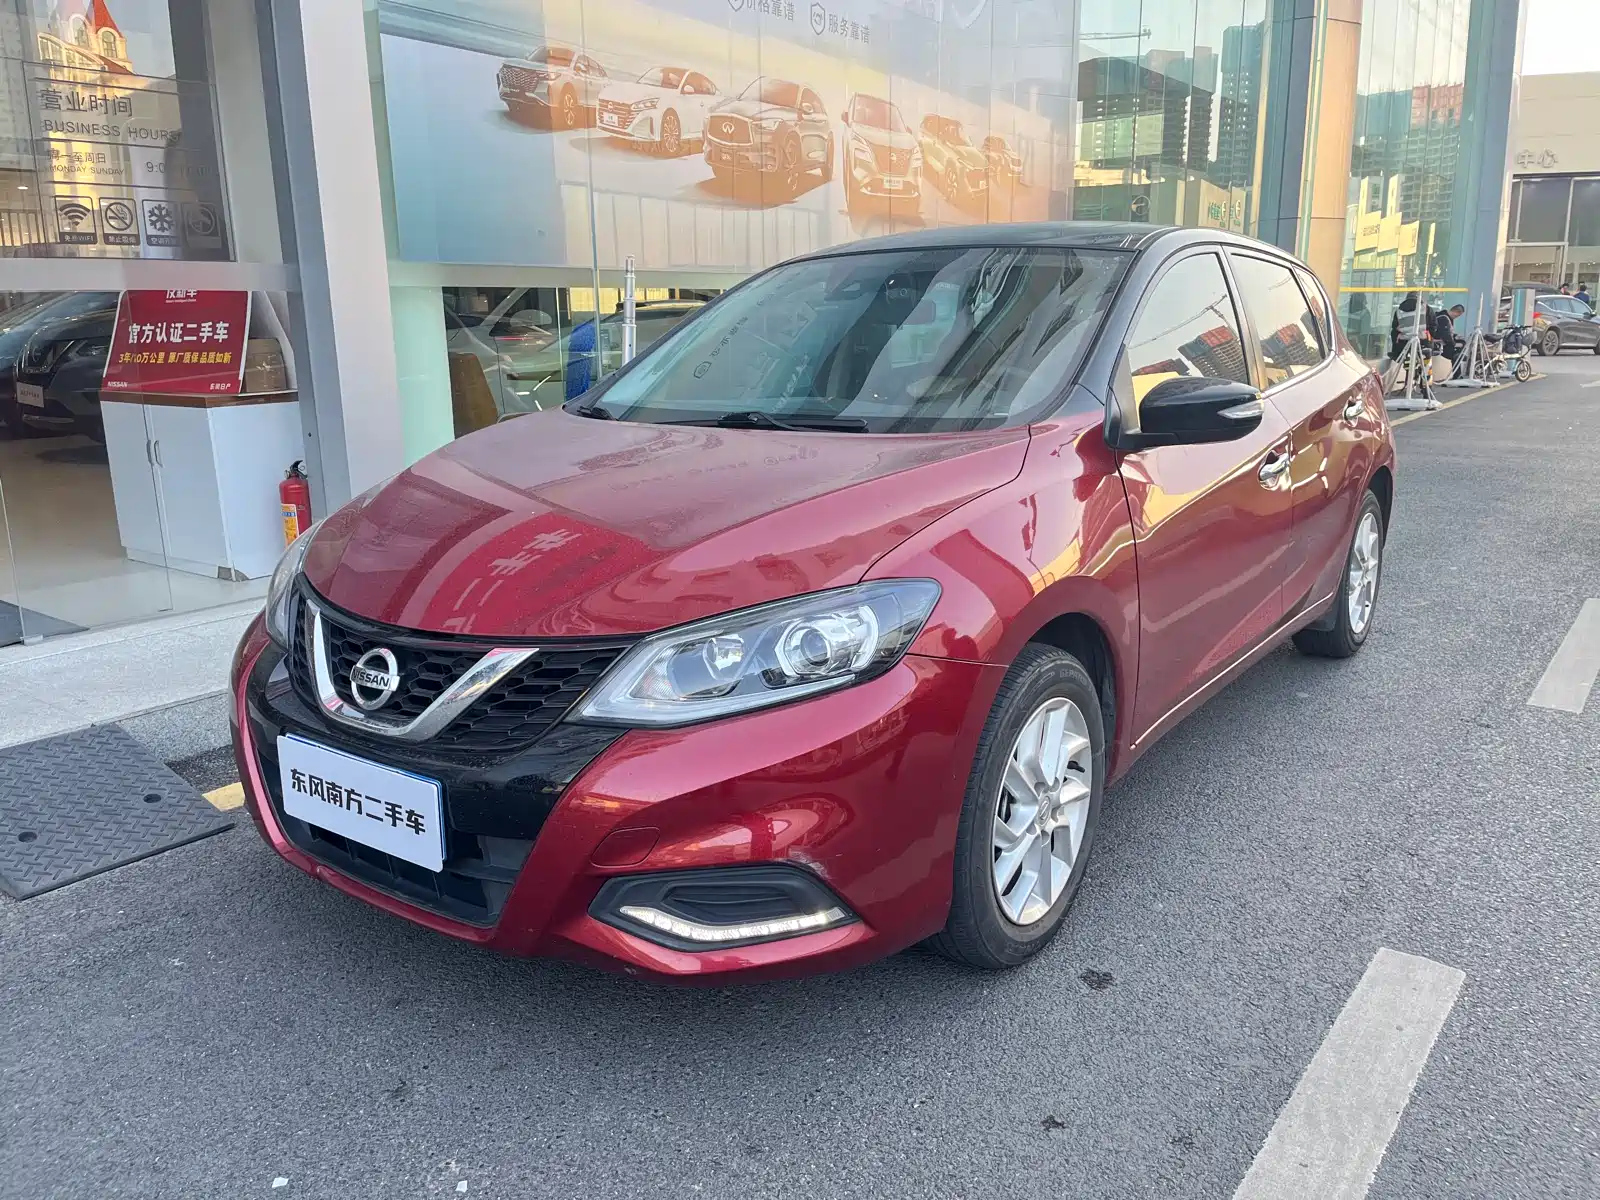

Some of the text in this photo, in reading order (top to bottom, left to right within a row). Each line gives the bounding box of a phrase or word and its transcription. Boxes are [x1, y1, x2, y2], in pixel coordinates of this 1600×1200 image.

[828, 13, 871, 44] 服务靠谱
[41, 88, 133, 117] 营业时间
[44, 119, 181, 142] BUSINESS HOURS
[48, 148, 106, 164] 周一至周日
[50, 164, 125, 176] MONDAY SUNDAY
[128, 321, 230, 344] 官方认证二手车
[352, 668, 390, 688] NISSAN
[290, 768, 426, 835] 东风南方二手车
